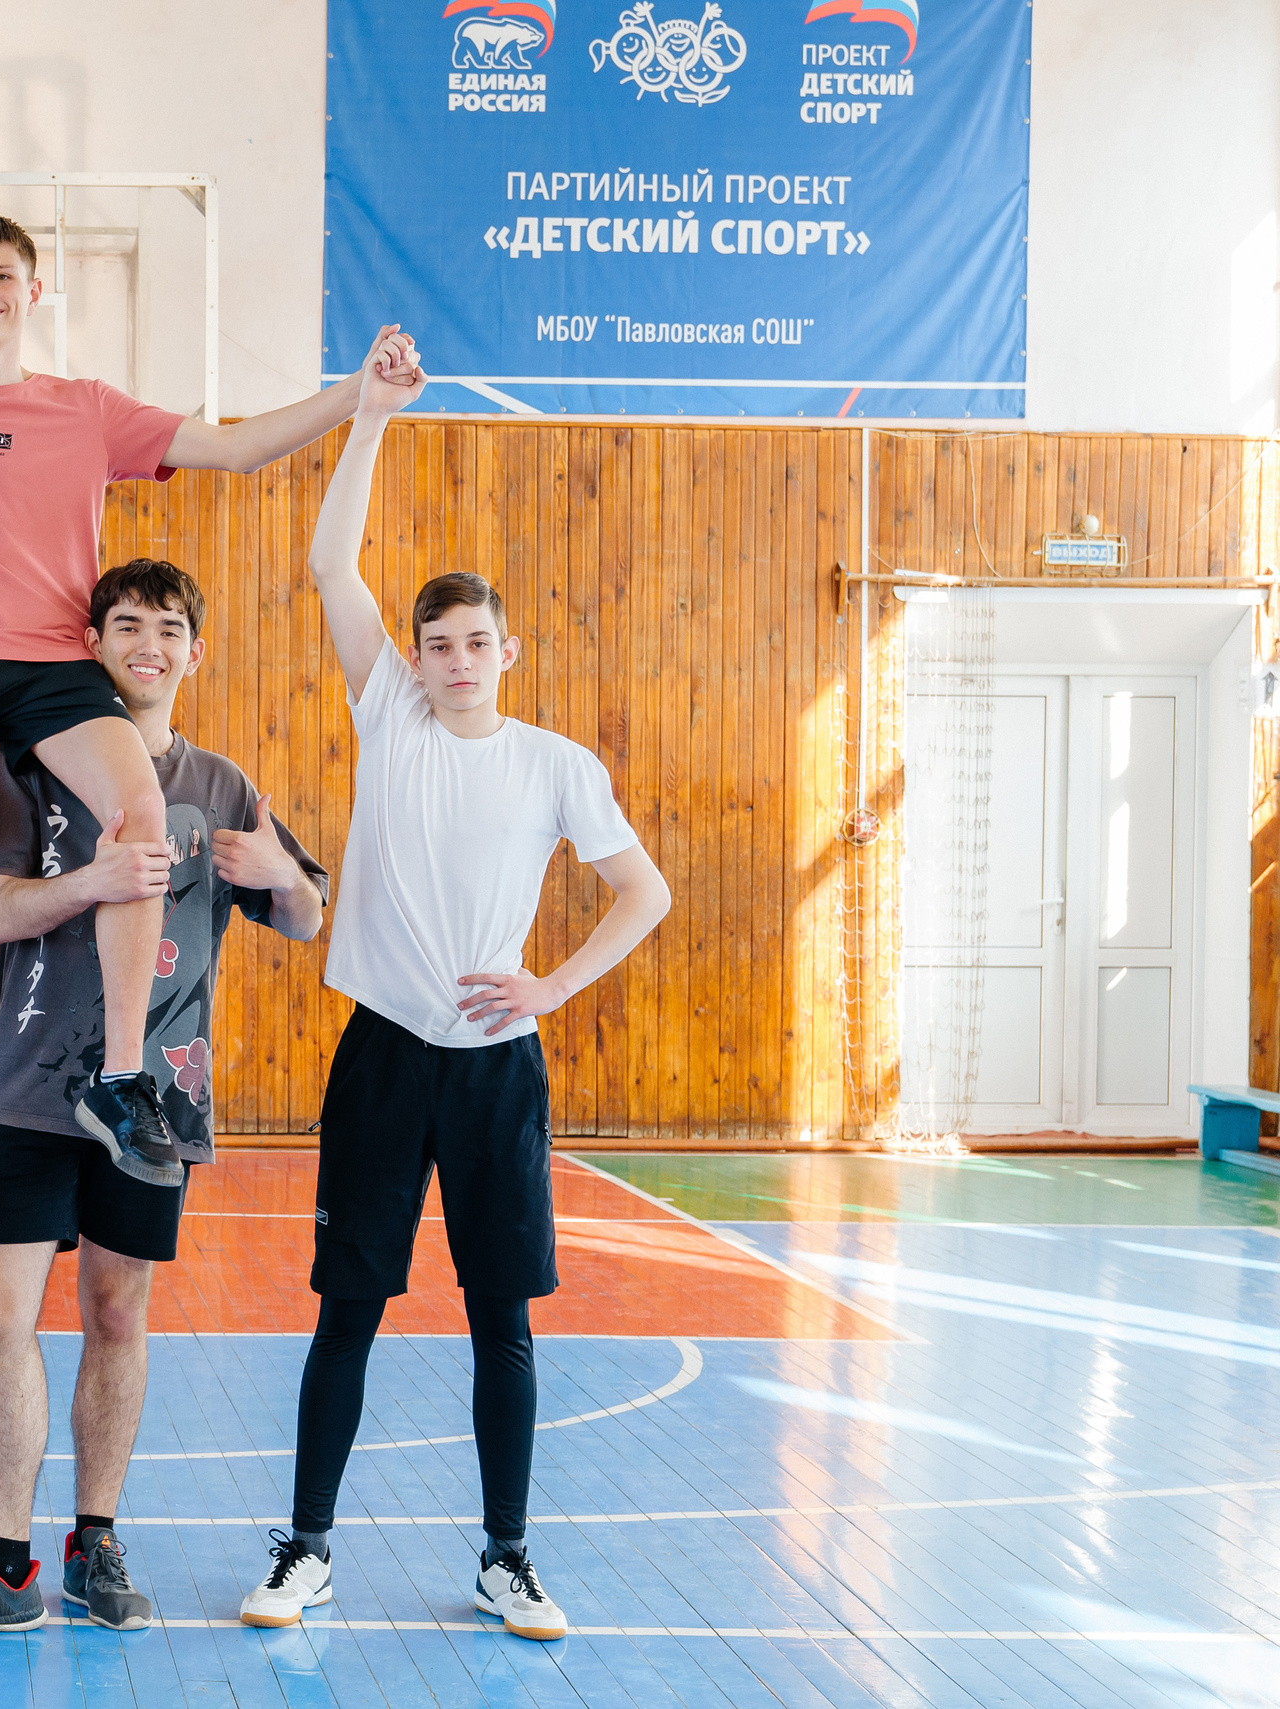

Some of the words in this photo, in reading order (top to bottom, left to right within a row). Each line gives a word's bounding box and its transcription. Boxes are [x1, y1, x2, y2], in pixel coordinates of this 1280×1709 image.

[802, 43, 891, 67] ПРОЕКТ
[448, 72, 547, 93] ЕДИНАЯ
[799, 68, 915, 98] ДЕТСКИЙ
[448, 93, 546, 113] РОССИЯ
[799, 101, 883, 125] СПОРТ
[506, 167, 713, 203] ПАРТИЙНЫЙ
[724, 175, 852, 205] ПРОЕКТ
[483, 210, 699, 259] «ДЕТСКИЙ
[710, 219, 872, 256] СПОРТ»
[536, 315, 599, 342] МБОУ
[1051, 546, 1112, 559] ВЫХОД
